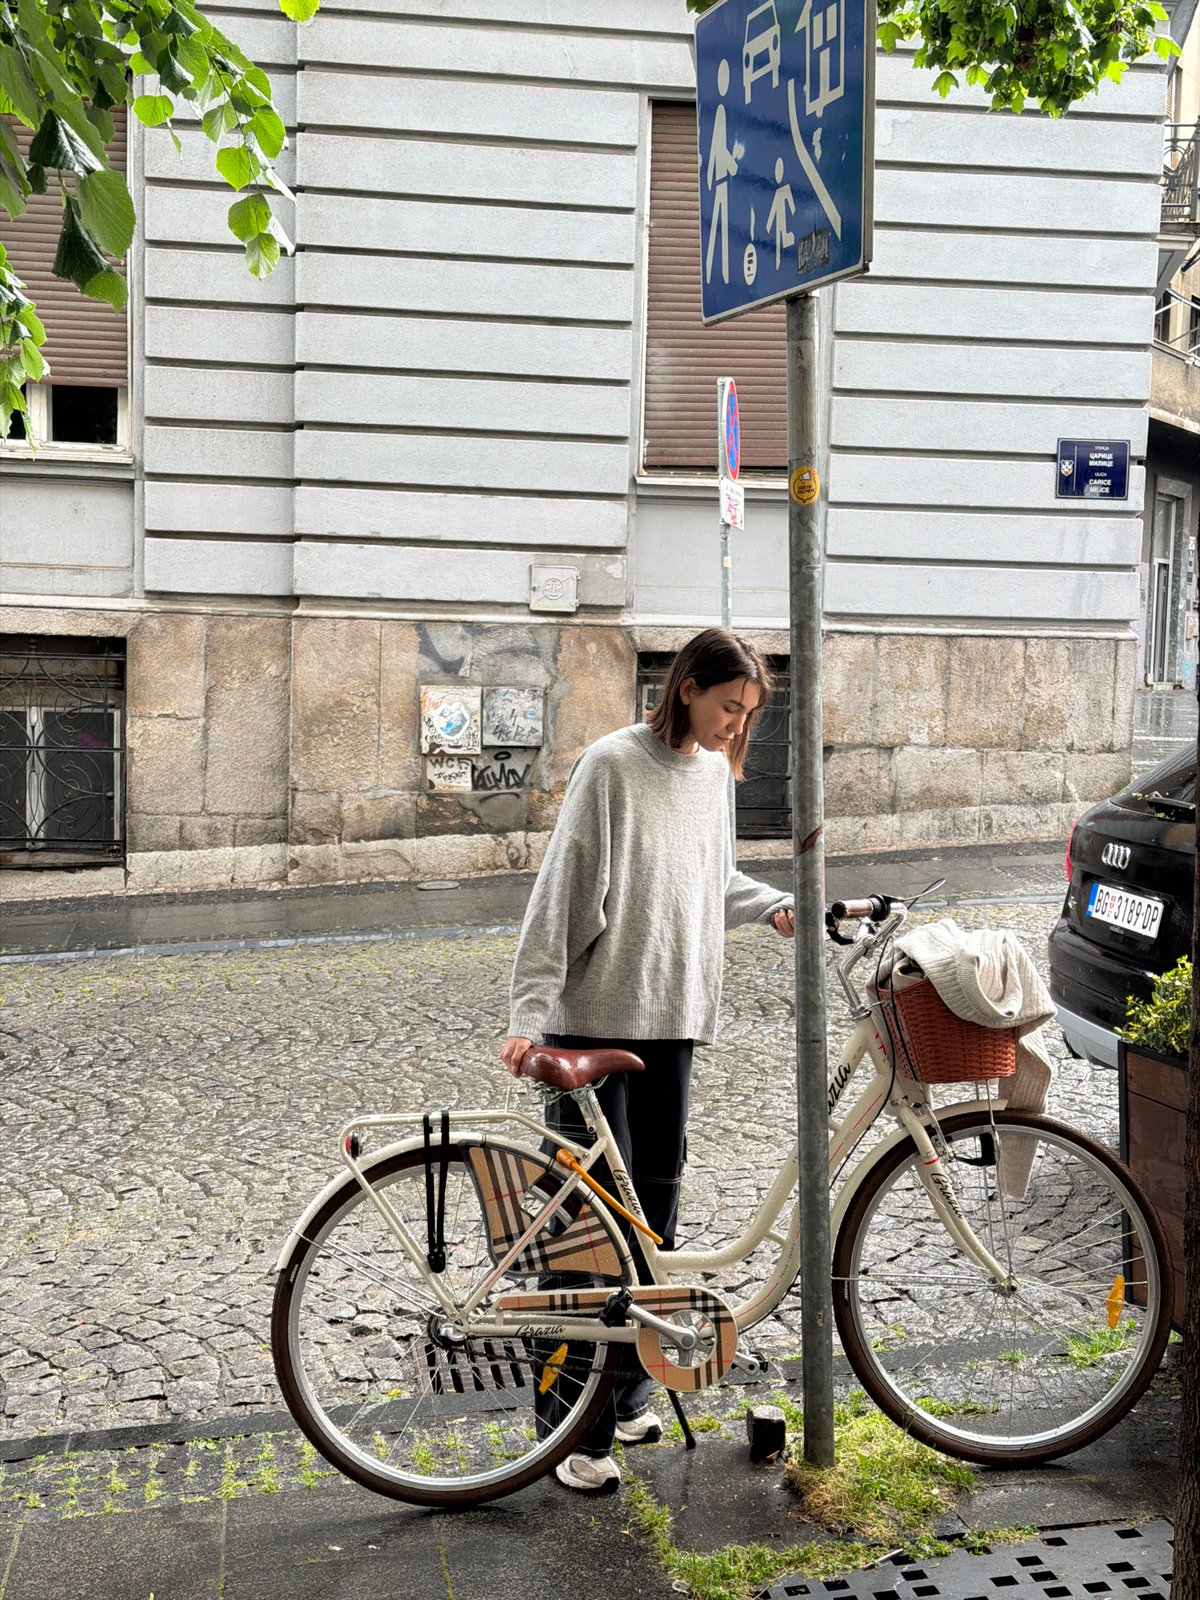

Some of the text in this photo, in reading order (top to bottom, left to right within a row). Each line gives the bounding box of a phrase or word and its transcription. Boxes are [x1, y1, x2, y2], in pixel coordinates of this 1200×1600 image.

[1089, 452, 1114, 460] ЦАРИЦЕ
[1088, 460, 1114, 468] МИЛИЦЕ
[1088, 478, 1112, 486] CARICE
[1089, 486, 1111, 494] MILICE
[1095, 889, 1110, 916] BG
[514, 1324, 566, 1338] Grazia
